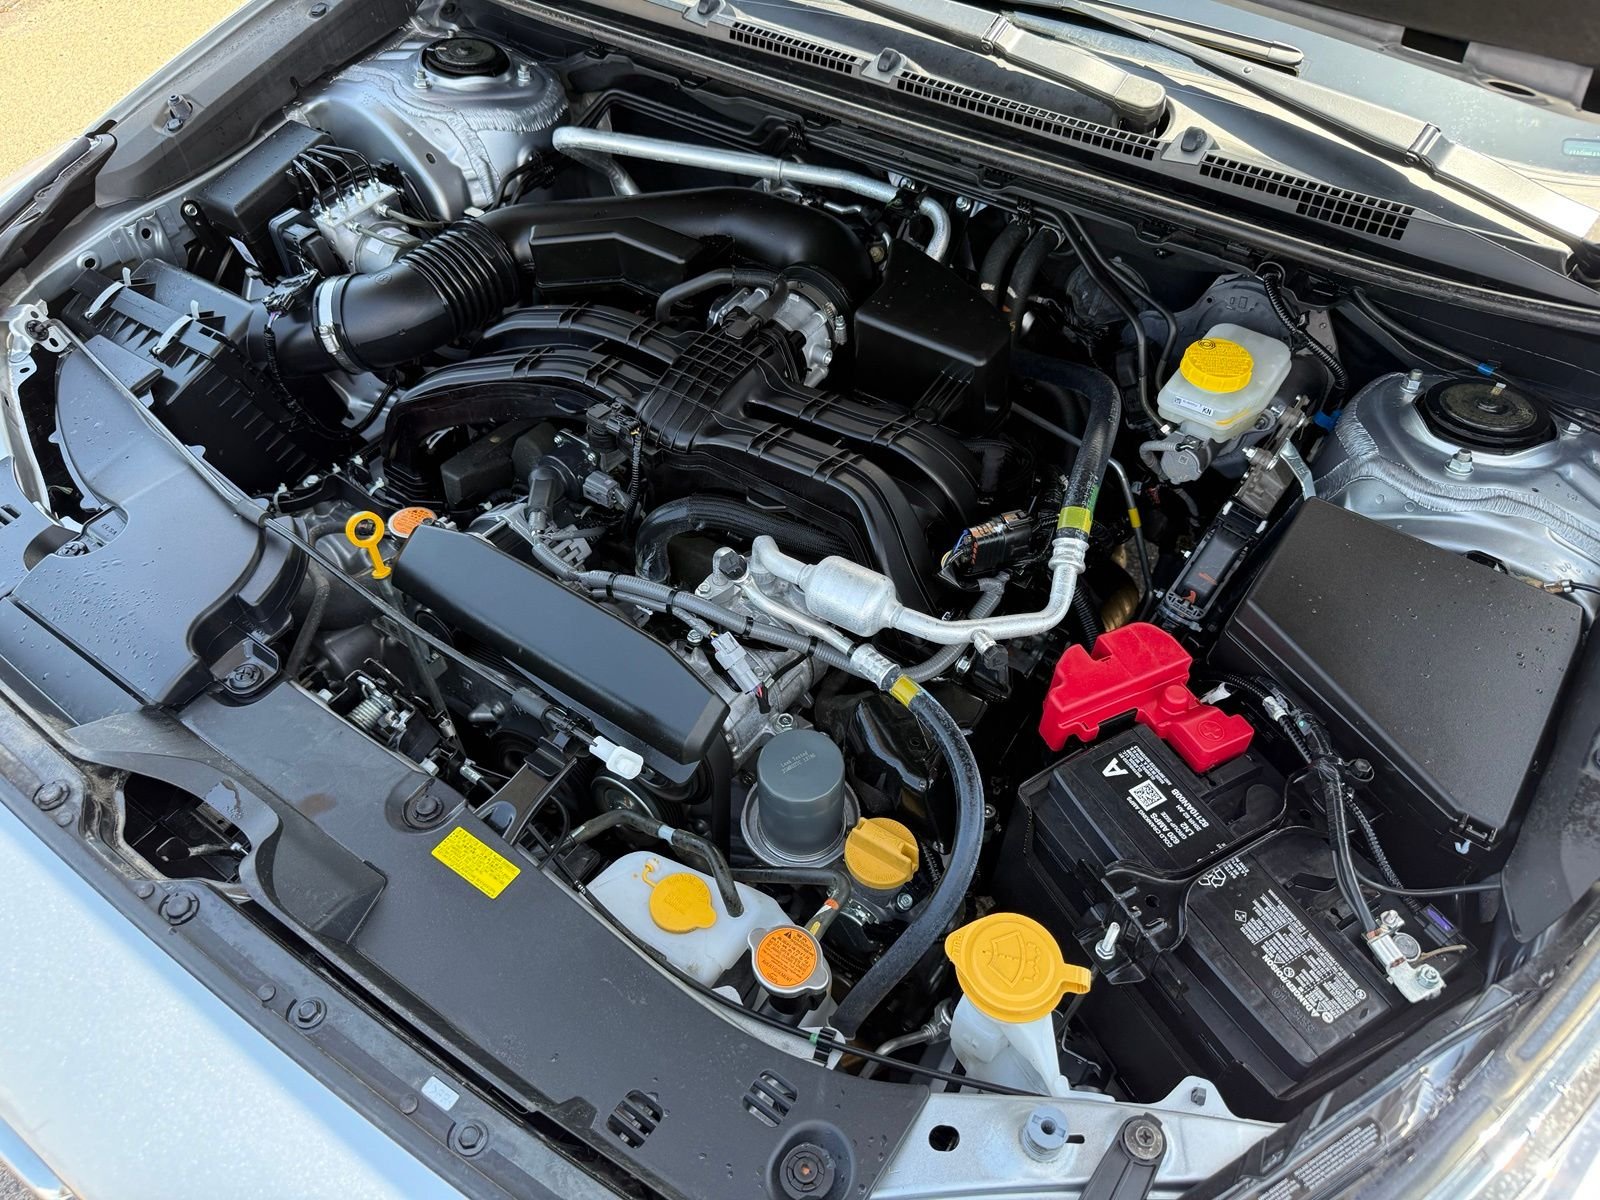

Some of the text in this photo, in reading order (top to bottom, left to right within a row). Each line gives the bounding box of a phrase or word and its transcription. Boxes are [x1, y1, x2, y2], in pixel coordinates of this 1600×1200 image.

[1102, 757, 1128, 777] A
[1170, 787, 1209, 827] 82110AN00B
[1175, 804, 1185, 812] AH
[1126, 796, 1173, 847] COLD CRANKING AMPS
[1149, 812, 1180, 843] 620 AMPS
[1159, 811, 1187, 839] GROUP SIZE
[1179, 822, 1195, 835] LN2
[1187, 817, 1202, 831] 20HR
[1261, 954, 1313, 1010] DANGER/POISON
